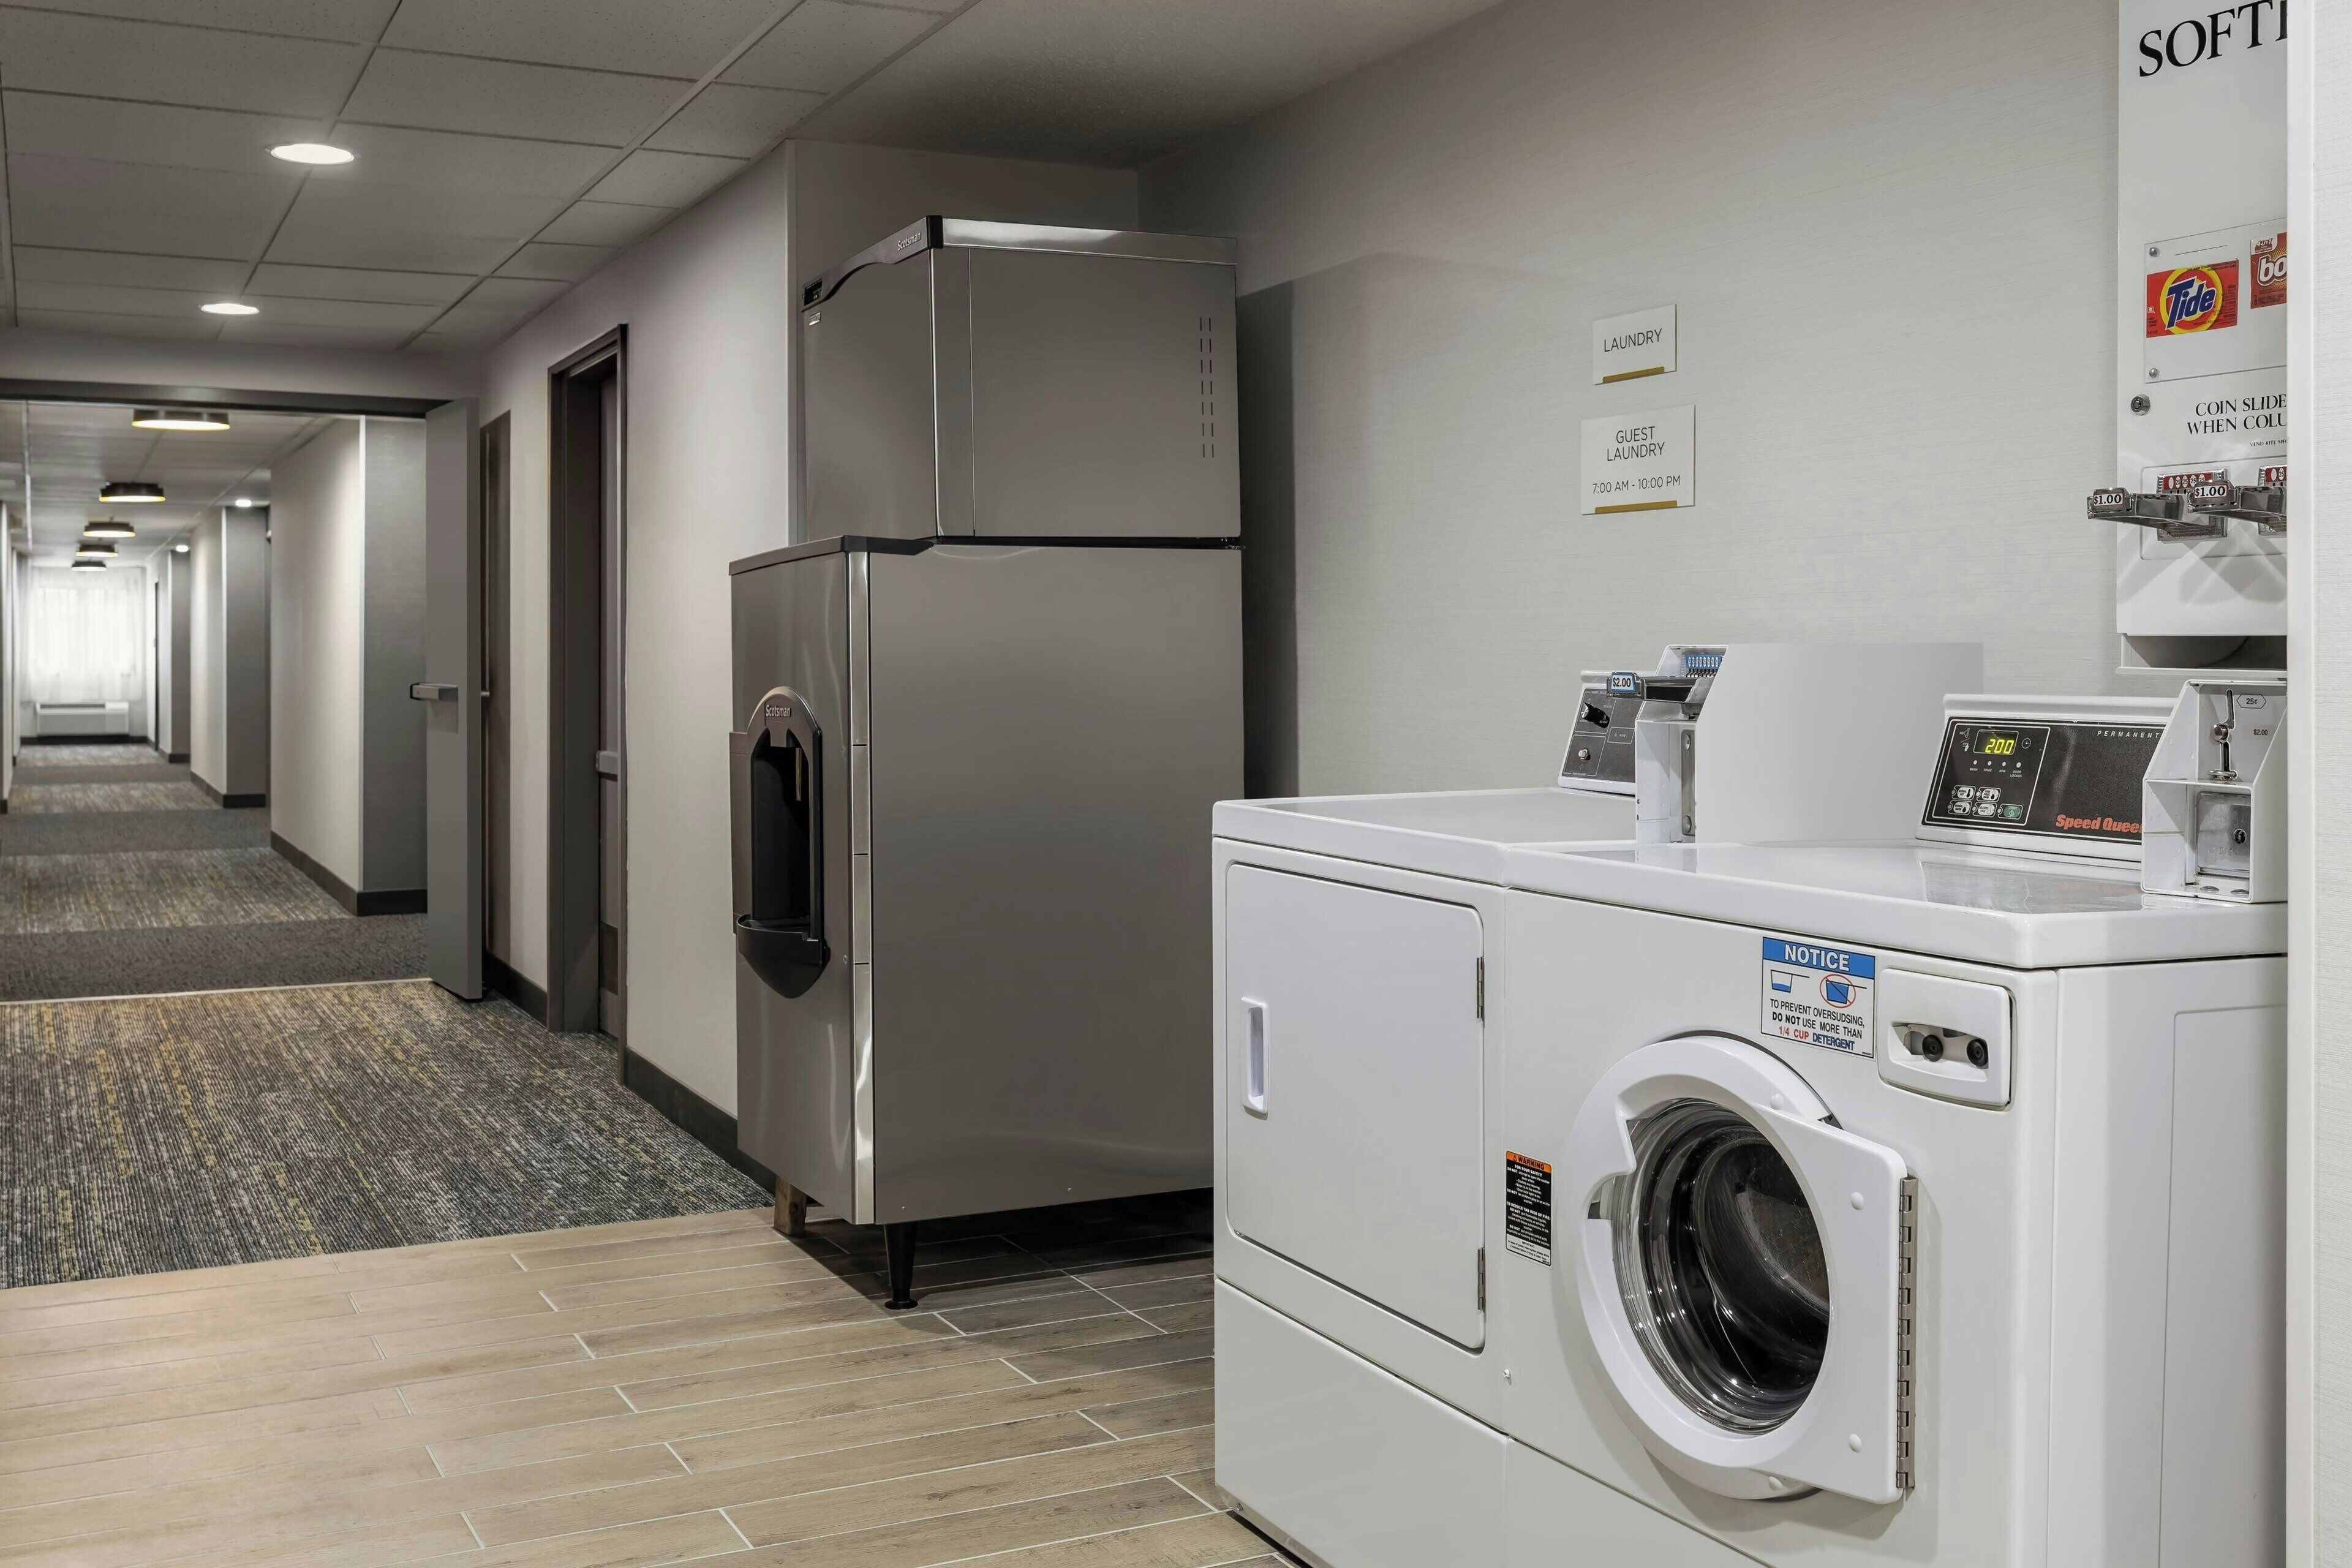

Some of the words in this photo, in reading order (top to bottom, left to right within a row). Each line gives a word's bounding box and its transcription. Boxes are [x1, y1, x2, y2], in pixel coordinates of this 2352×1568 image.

[897, 232, 921, 251] Scotsman
[2165, 276, 2217, 330] Tide
[1604, 328, 1662, 352] LAUNDRY
[2196, 399, 2236, 417] COIN
[2242, 394, 2287, 412] SLIDE
[1616, 426, 1655, 443] GUEST
[2187, 418, 2236, 435] WHEN
[1607, 442, 1665, 462] LAUNDRY
[1593, 482, 1611, 494] 7:00
[1615, 480, 1629, 492] AM
[1638, 477, 1663, 489] 10:00
[1667, 475, 1680, 486] PM
[2195, 486, 2226, 497] $1.00
[2093, 494, 2122, 506] $1.00
[1612, 677, 1631, 688] $2.00
[766, 704, 791, 717] Scotsman
[1985, 739, 2015, 754] 200
[2056, 814, 2102, 830] Speed
[1785, 943, 1850, 972] NOTICE
[1770, 999, 1779, 1009] TO
[1781, 1001, 1811, 1016] PREVENT
[1813, 1008, 1864, 1029] OVERSUDSING,
[1773, 1012, 1782, 1022] DO
[1786, 1014, 1800, 1026] NOT
[1803, 1018, 1816, 1029] USE
[1820, 1022, 1839, 1034] MORE
[1843, 1027, 1862, 1039] THAN
[1779, 1025, 1789, 1036] 1/4
[1794, 1028, 1809, 1040] CUP
[1813, 1032, 1855, 1051] DETERGENT
[1518, 1156, 1544, 1170] WARNING
